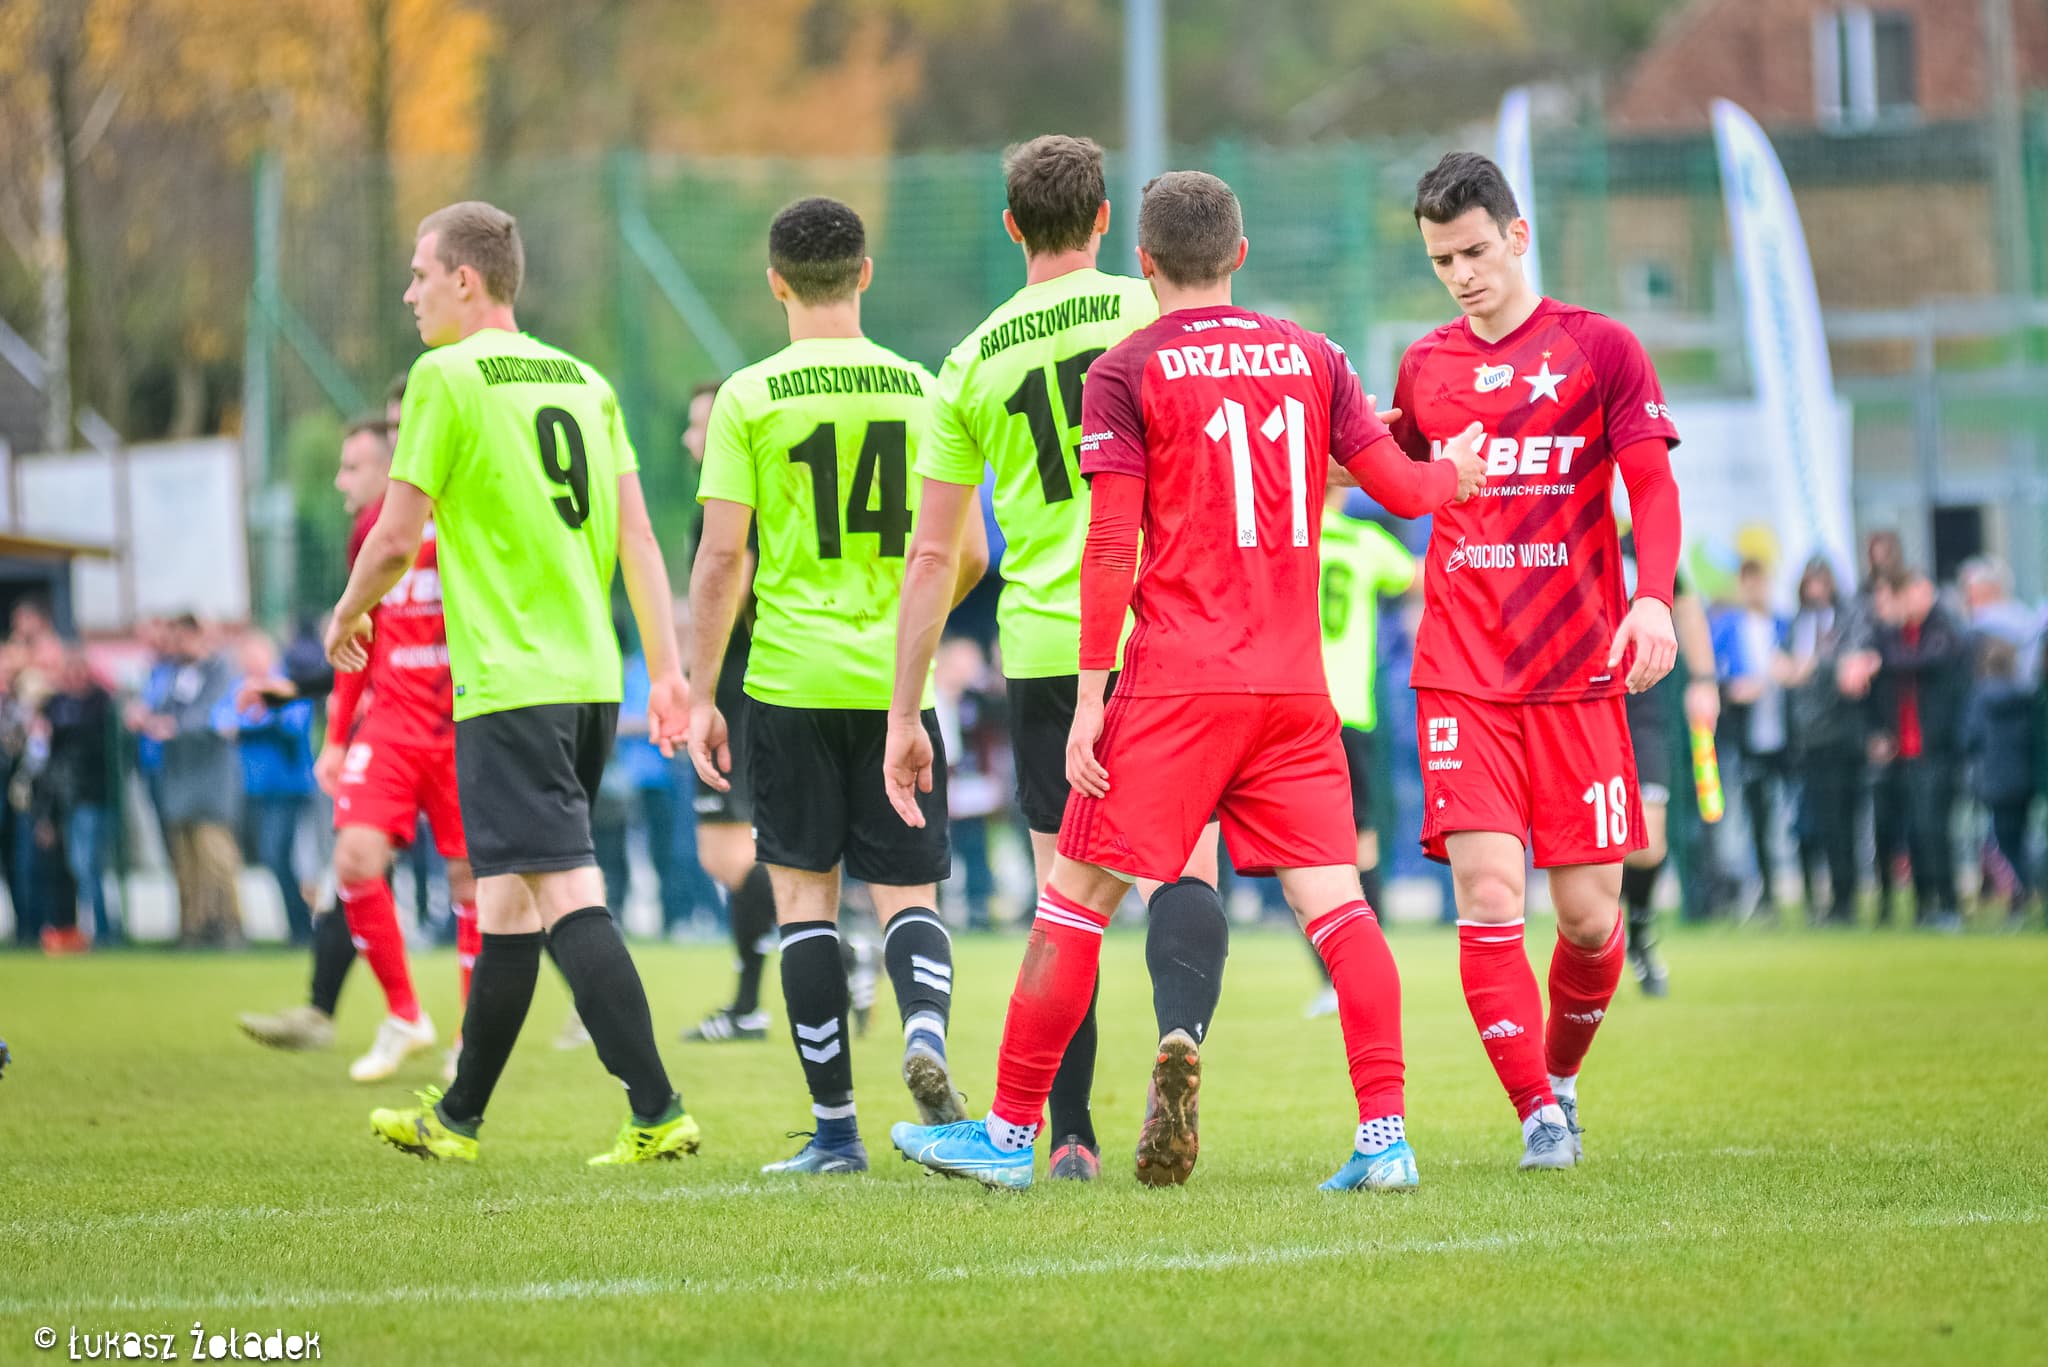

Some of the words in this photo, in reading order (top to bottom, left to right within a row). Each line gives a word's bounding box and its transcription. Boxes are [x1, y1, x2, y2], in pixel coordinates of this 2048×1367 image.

[980, 295, 1121, 360] RADZISZOWIANKA
[476, 356, 588, 386] RADZISZOWIANKA
[767, 366, 924, 400] RADZISZOWIANKA
[1156, 343, 1313, 380] DRZAZGA
[1483, 371, 1506, 386] LOTTO
[536, 406, 590, 530] 9
[788, 421, 912, 559] 14
[1203, 394, 1310, 548] 11
[1467, 544, 1515, 568] SOCIOS
[1519, 542, 1569, 568] WISŁA
[1583, 776, 1628, 849] 18
